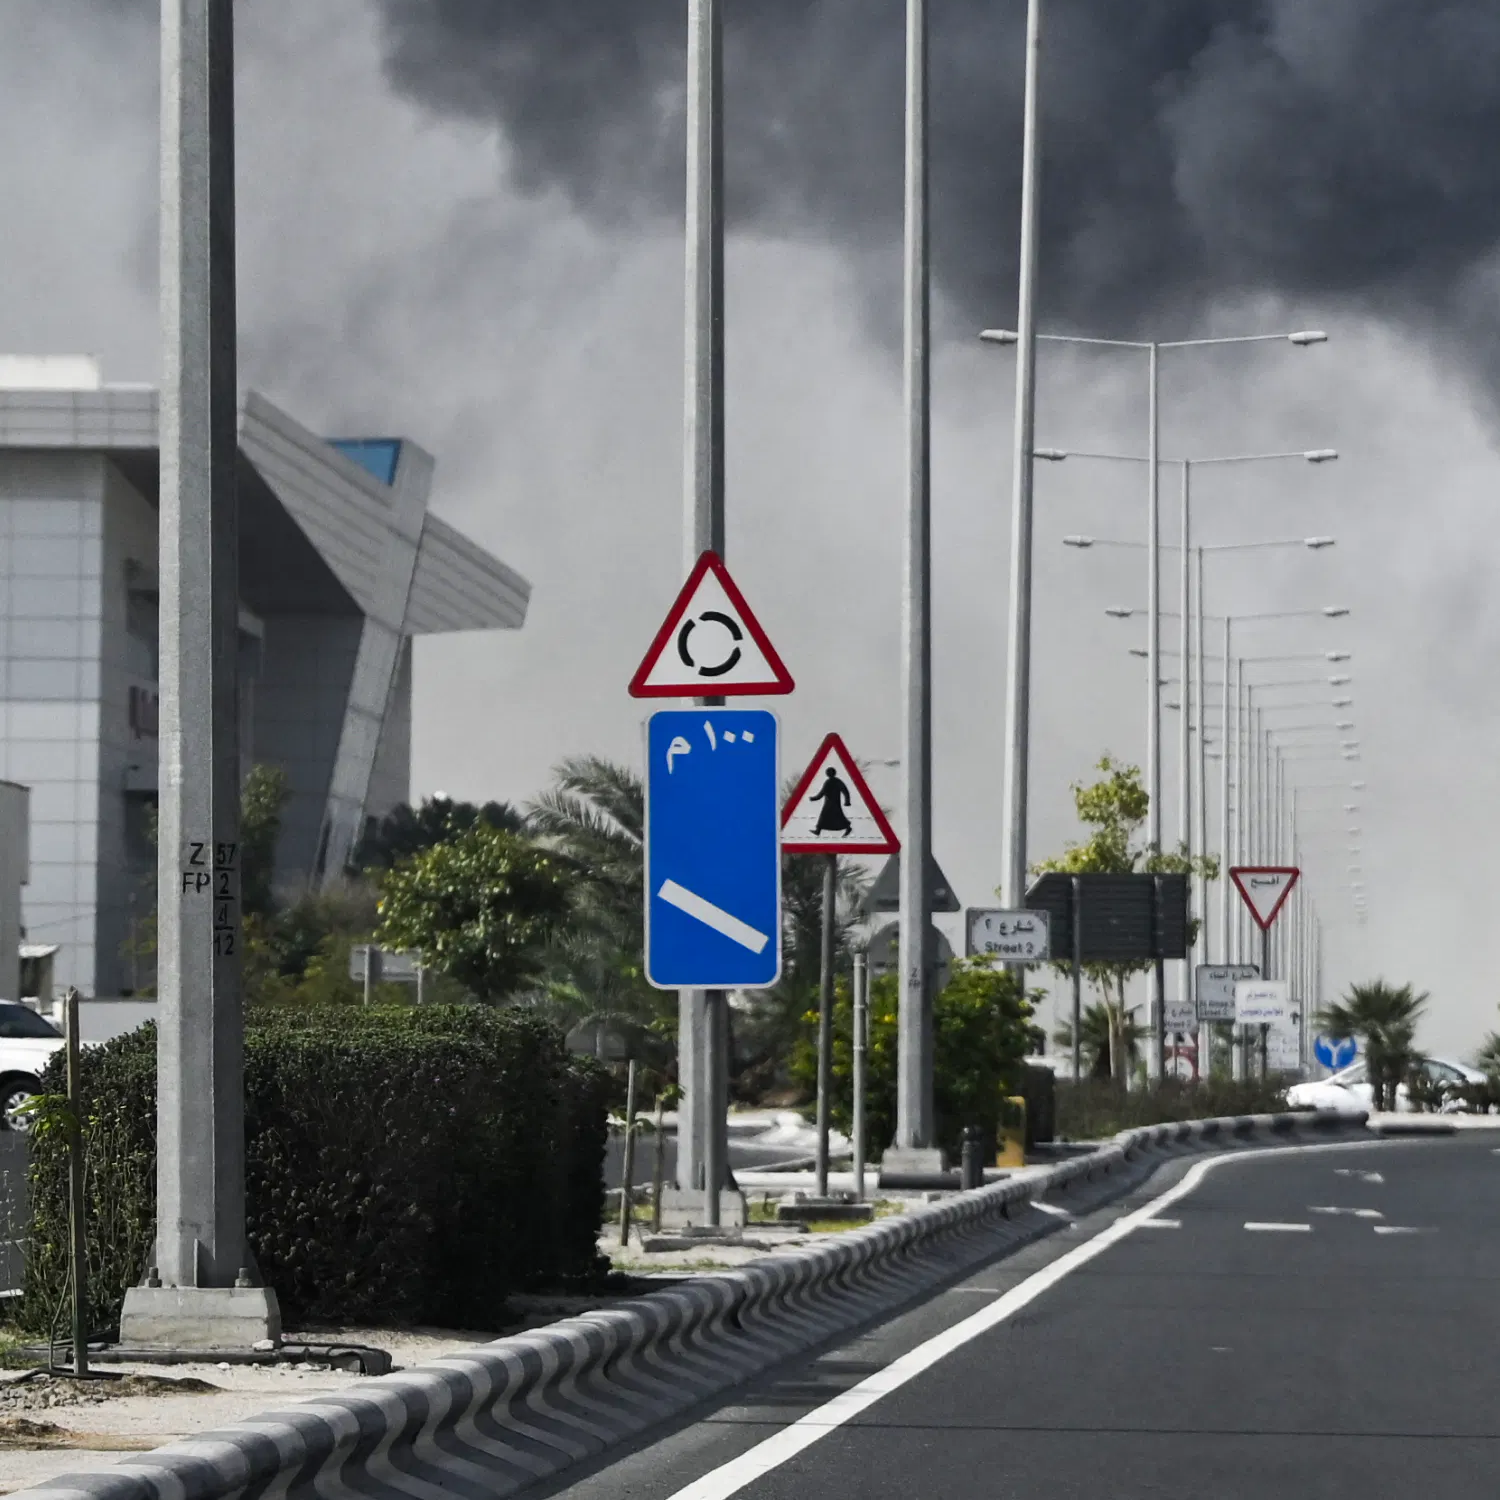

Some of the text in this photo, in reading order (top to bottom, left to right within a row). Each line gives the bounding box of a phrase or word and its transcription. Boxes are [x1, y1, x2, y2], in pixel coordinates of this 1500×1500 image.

[666, 719, 755, 774] ١٠٠ م
[189, 842, 236, 866] Z 57
[182, 872, 229, 895] FP 2
[214, 933, 235, 956] 12
[984, 941, 1034, 955] Street 2
